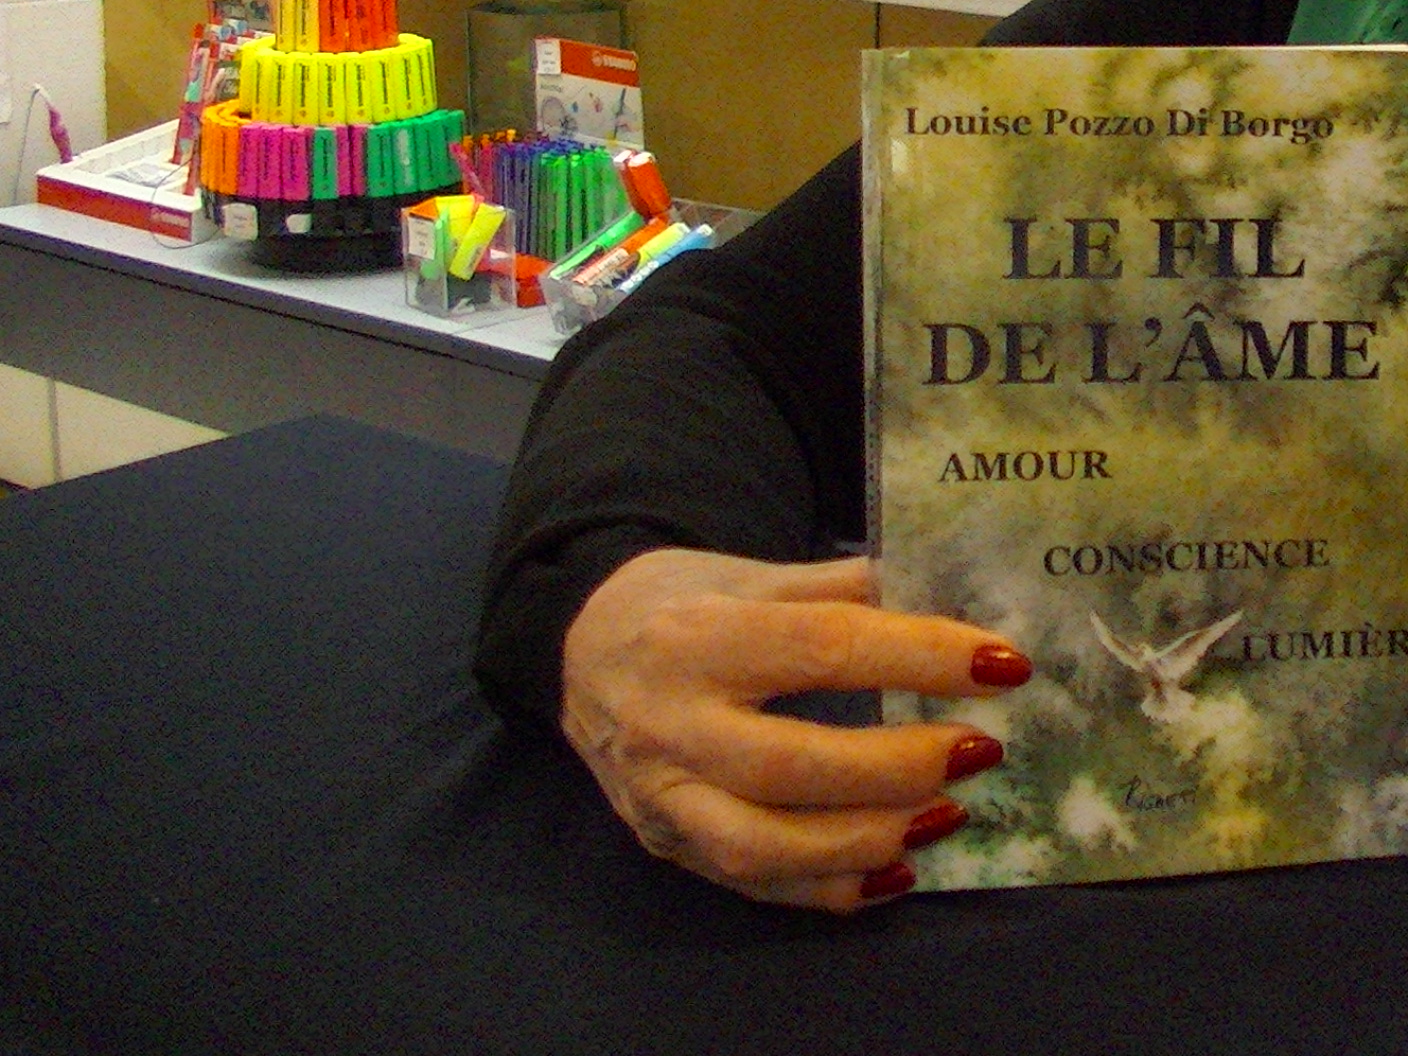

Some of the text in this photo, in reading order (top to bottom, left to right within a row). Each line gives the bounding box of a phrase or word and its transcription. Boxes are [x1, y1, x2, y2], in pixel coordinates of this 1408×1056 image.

[906, 106, 1336, 145] Louise Pozzo Di Borgo
[1001, 217, 1306, 280] LE FIL
[921, 321, 1058, 386] DE
[937, 449, 1114, 484] AMOUR
[1042, 538, 1332, 577] CONSCIENCE
